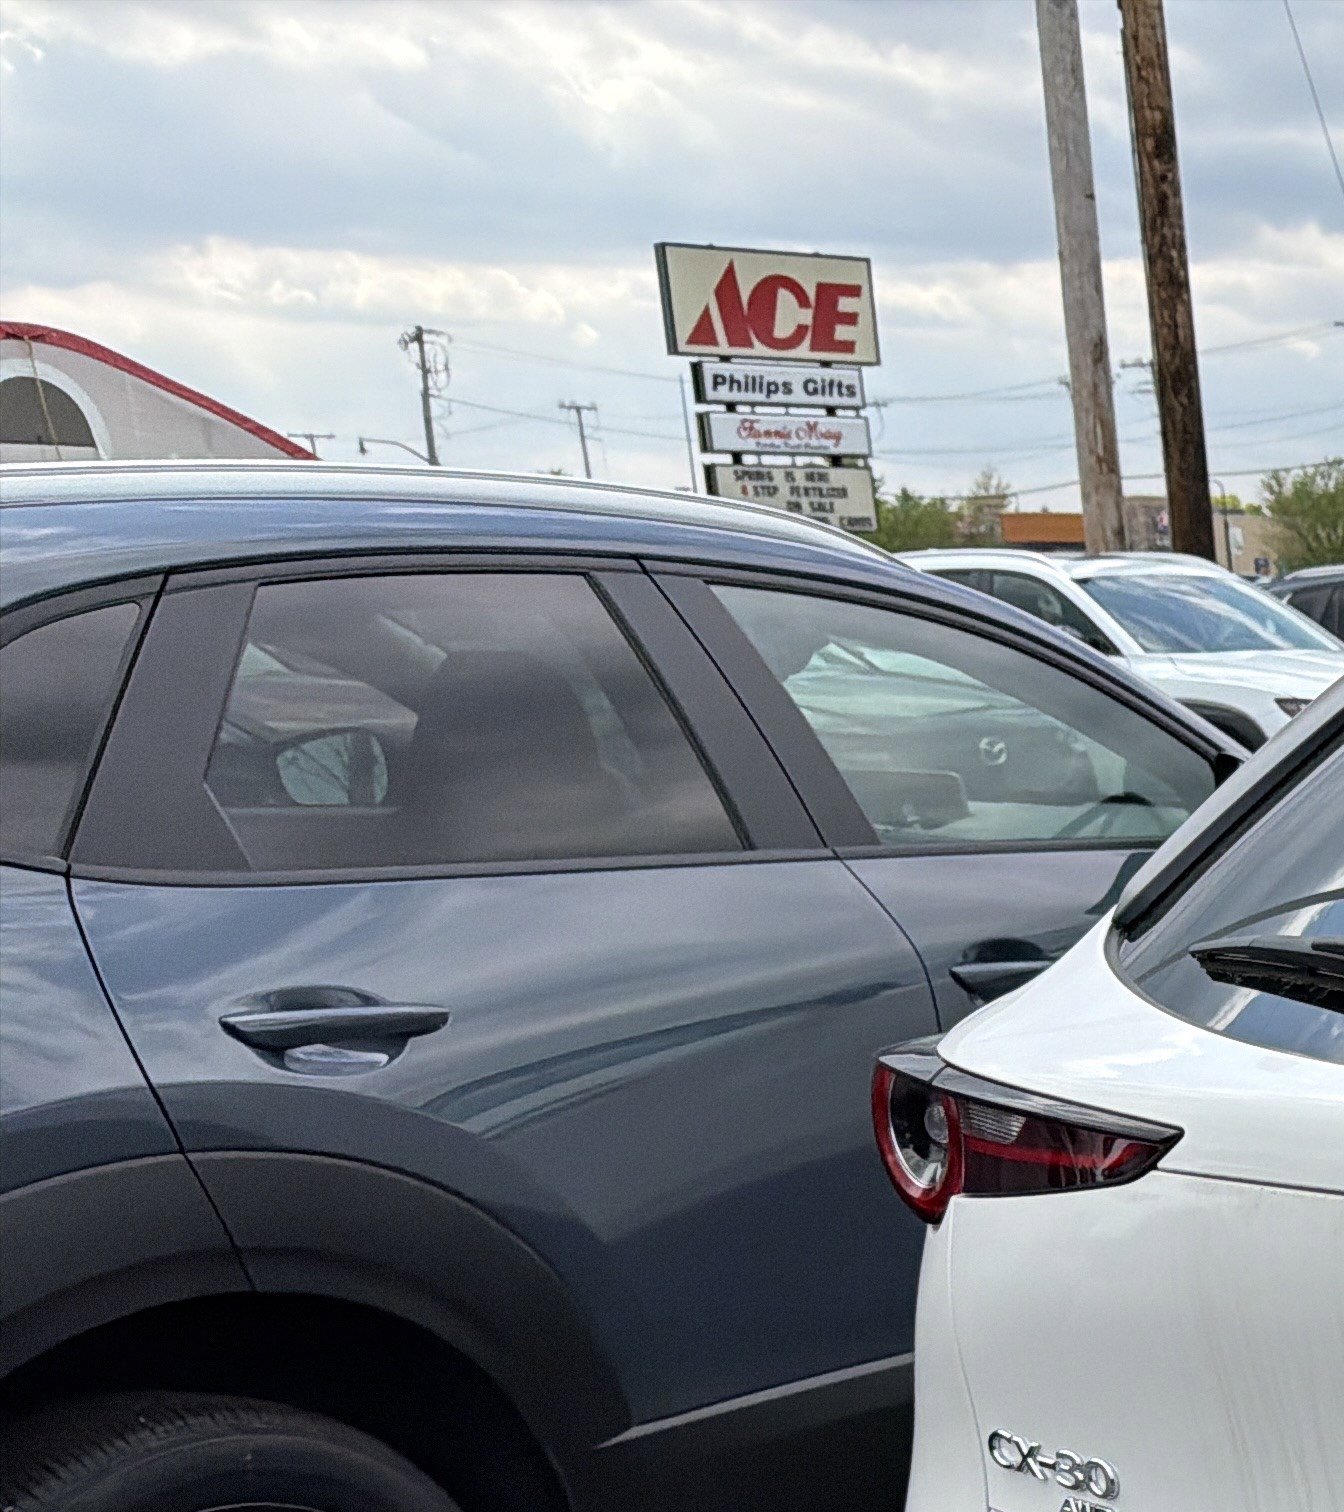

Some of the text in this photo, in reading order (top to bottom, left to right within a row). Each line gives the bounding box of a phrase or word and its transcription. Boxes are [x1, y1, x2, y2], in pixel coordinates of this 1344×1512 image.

[685, 258, 863, 355] ACE
[712, 373, 857, 399] Philips Gifts
[987, 1428, 1121, 1500] CX-30
